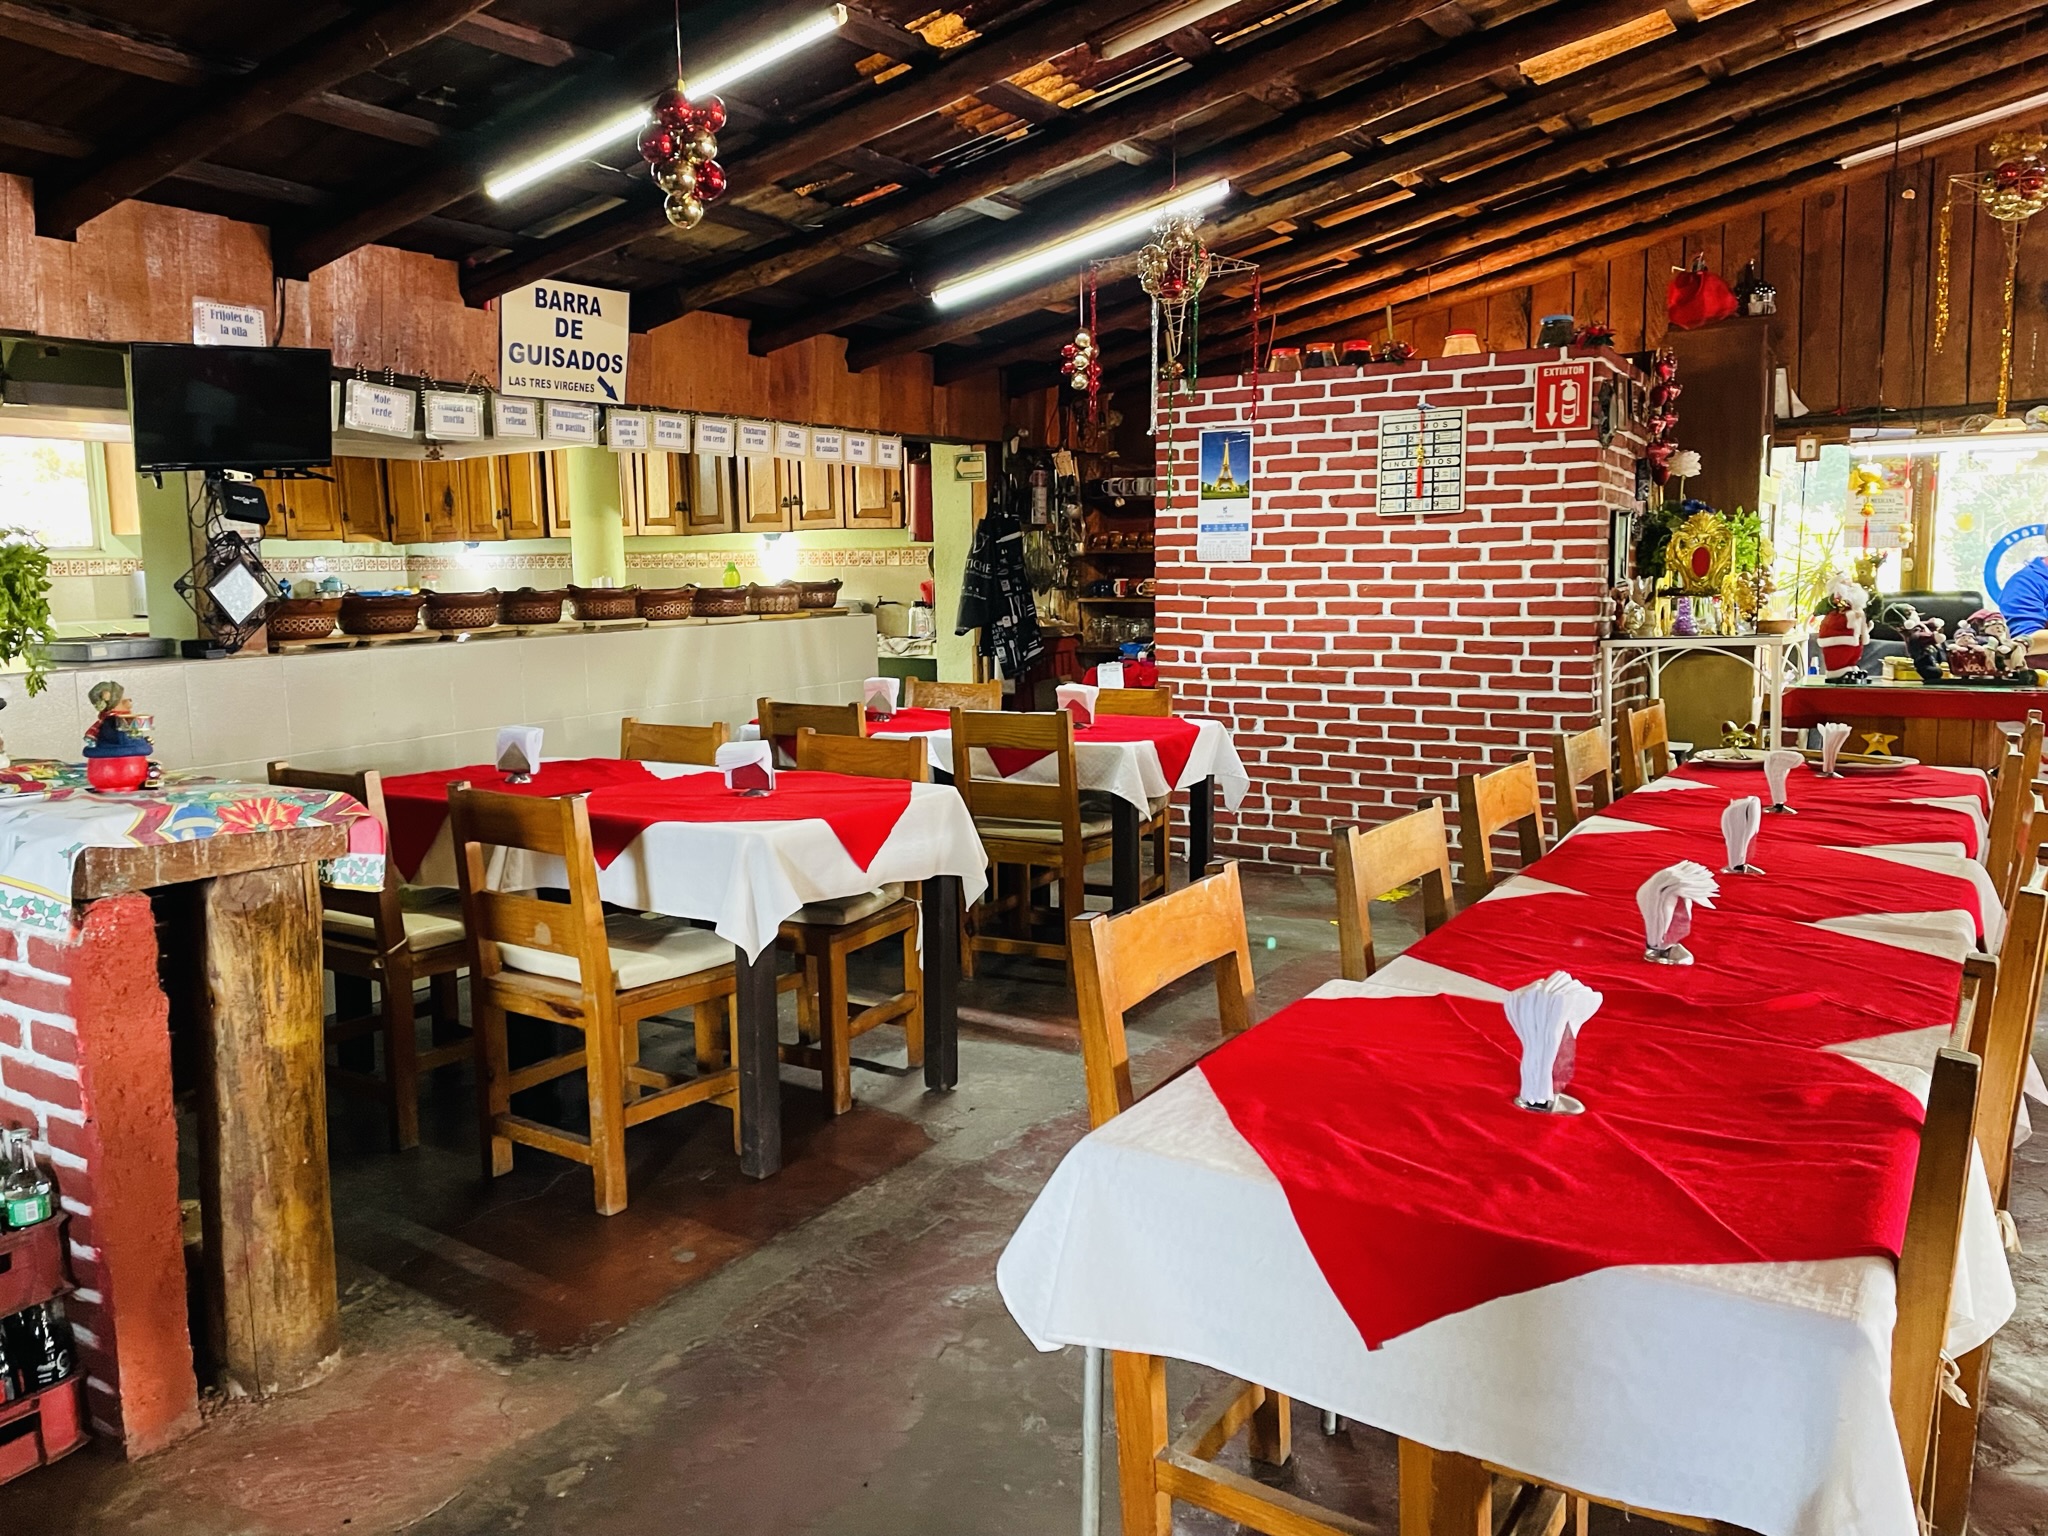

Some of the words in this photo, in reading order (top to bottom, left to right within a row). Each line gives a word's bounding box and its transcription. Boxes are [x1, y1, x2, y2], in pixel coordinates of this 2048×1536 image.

[535, 287, 602, 317] BARRA
[210, 309, 242, 323] Frijoles
[244, 314, 254, 324] de
[220, 324, 229, 335] la
[232, 326, 248, 337] olla
[555, 317, 583, 340] DE
[508, 342, 623, 374] GUISADOS
[1543, 365, 1585, 377] EXTINTOR
[508, 376, 527, 387] LAS
[529, 378, 551, 389] TRES
[554, 380, 595, 393] VIRGENES
[374, 393, 391, 405] Mole
[371, 407, 393, 418] verde
[465, 404, 473, 413] en
[503, 404, 528, 415] Pechugas
[443, 414, 465, 424] morita
[506, 416, 527, 426] rellenas
[676, 420, 682, 429] de
[556, 423, 563, 431] en
[565, 423, 586, 433] pasilla
[1394, 420, 1448, 431] SISMOS
[1389, 458, 1452, 467] INCEDIOS
